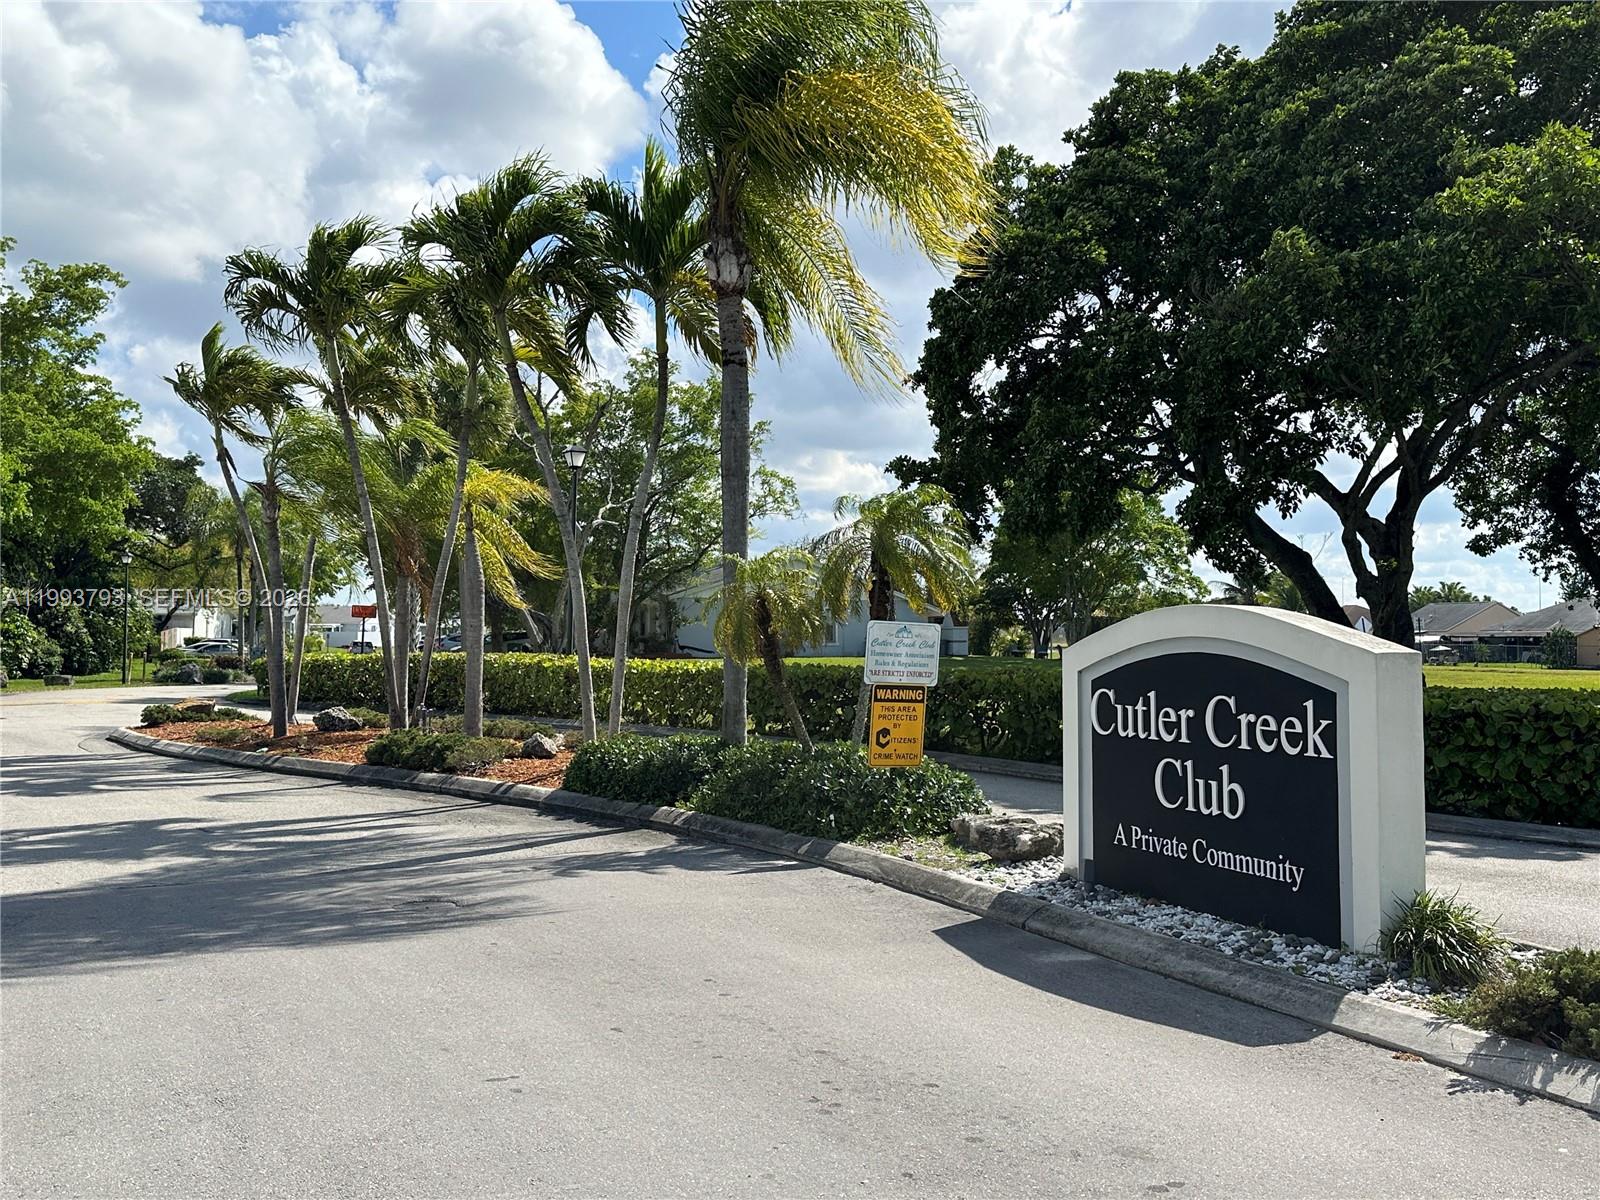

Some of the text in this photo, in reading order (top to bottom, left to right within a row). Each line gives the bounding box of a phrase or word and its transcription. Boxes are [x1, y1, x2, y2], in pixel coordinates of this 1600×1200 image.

[870, 637, 936, 649] Cutler Creek Club
[898, 660, 929, 669] Regulations
[876, 688, 924, 700] WARNING
[1091, 688, 1334, 759] Cutler Creek
[1154, 757, 1246, 820] Club
[1113, 823, 1305, 892] A Private Community
